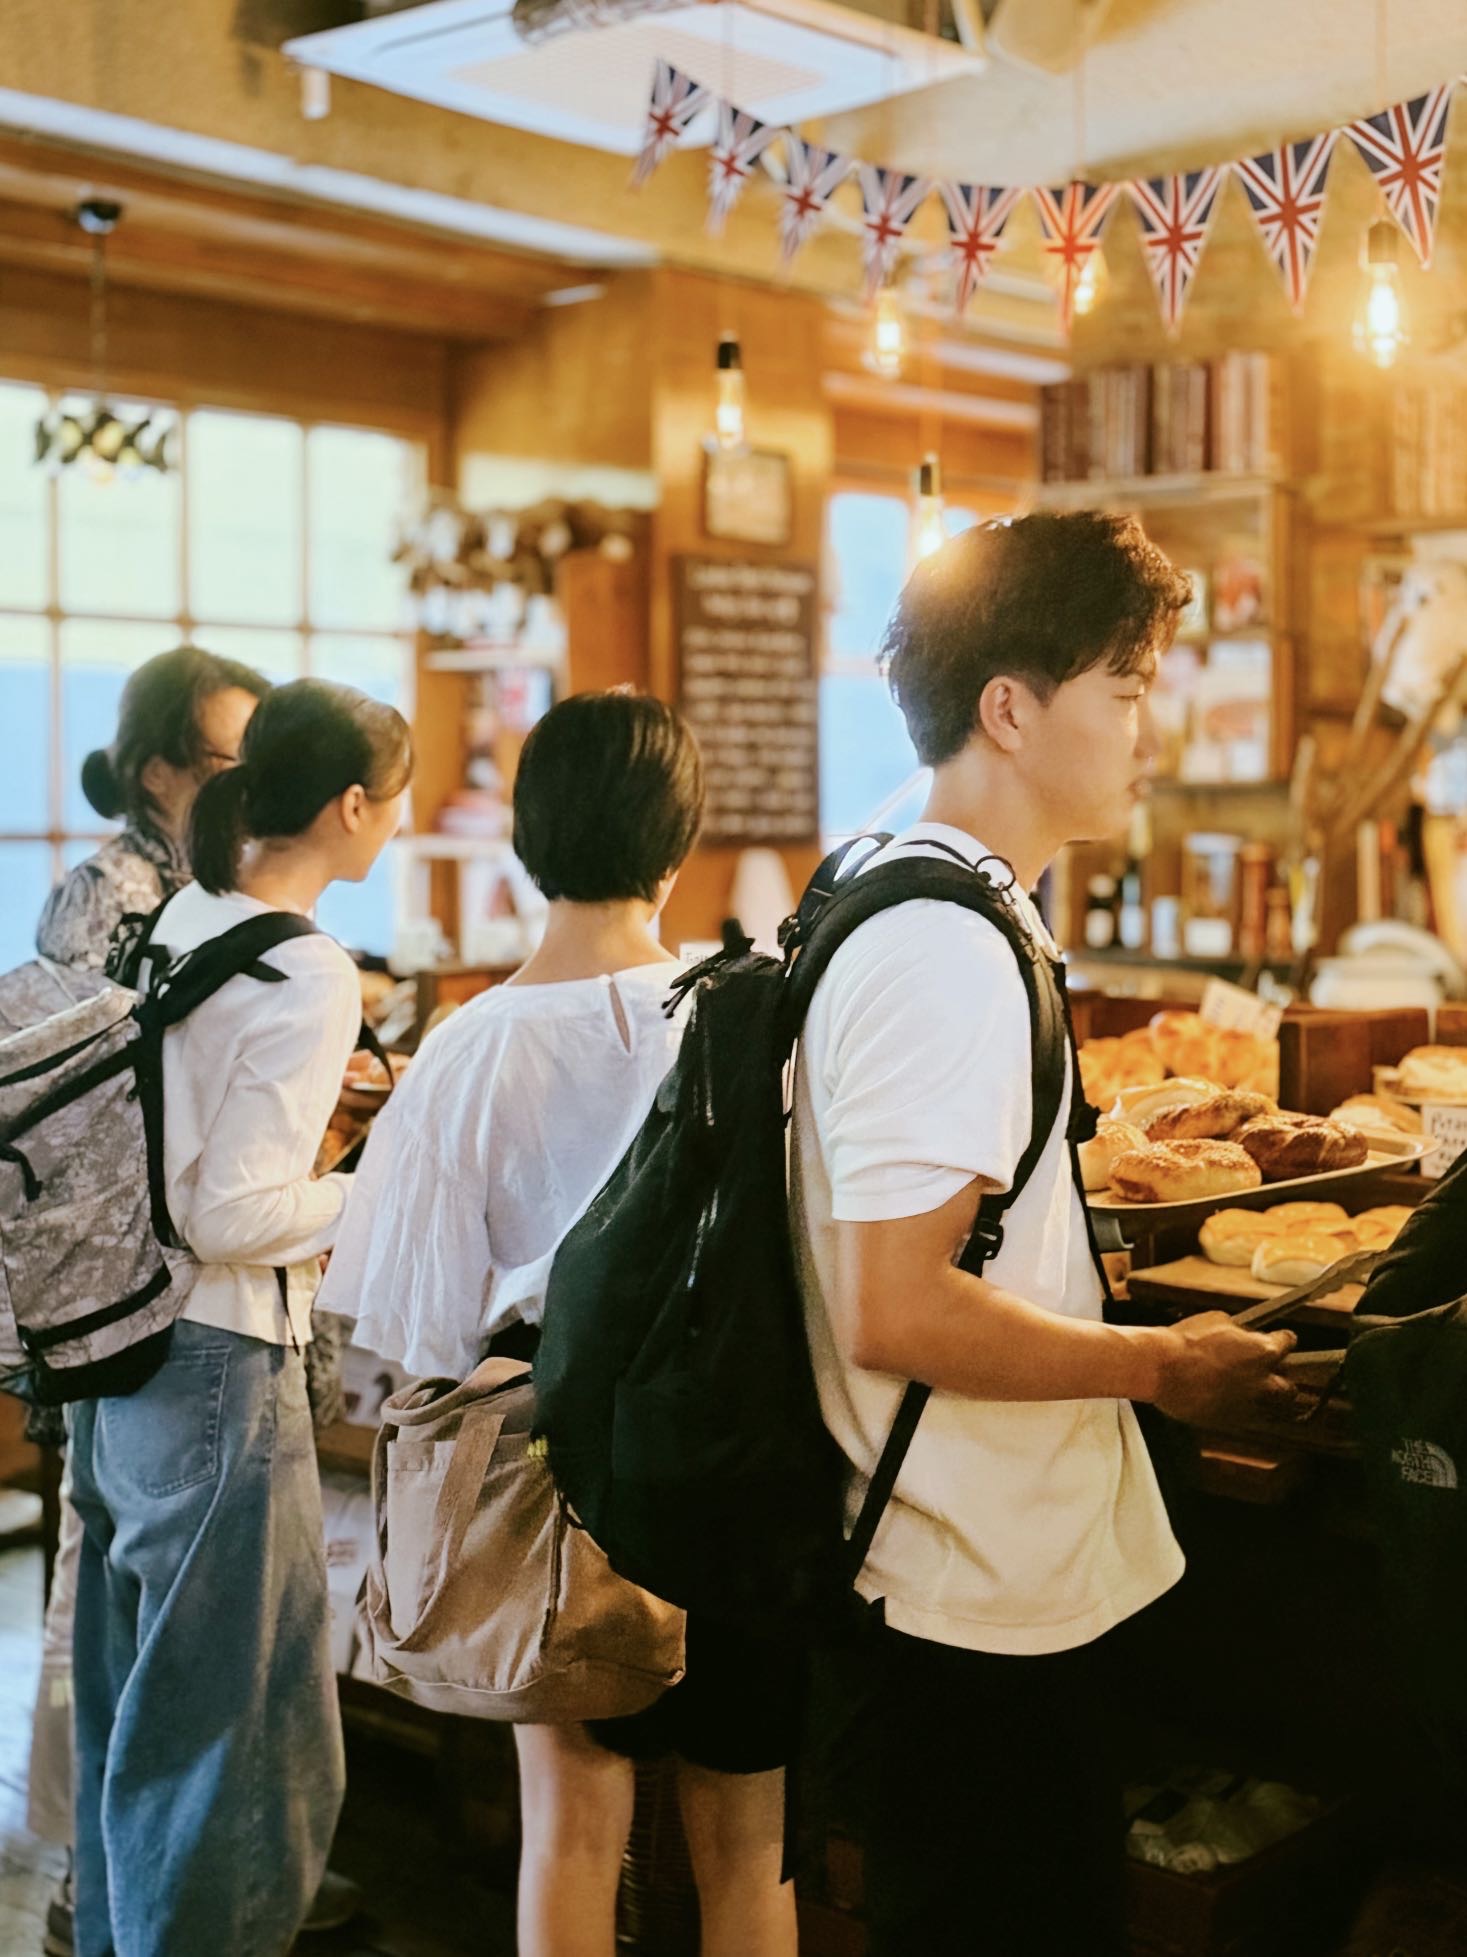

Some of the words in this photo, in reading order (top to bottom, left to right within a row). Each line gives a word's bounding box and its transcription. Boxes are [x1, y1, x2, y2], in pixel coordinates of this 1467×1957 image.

[1401, 1438, 1422, 1455] THE
[1392, 1449, 1432, 1470] NORTH
[1401, 1466, 1433, 1485] FACE
